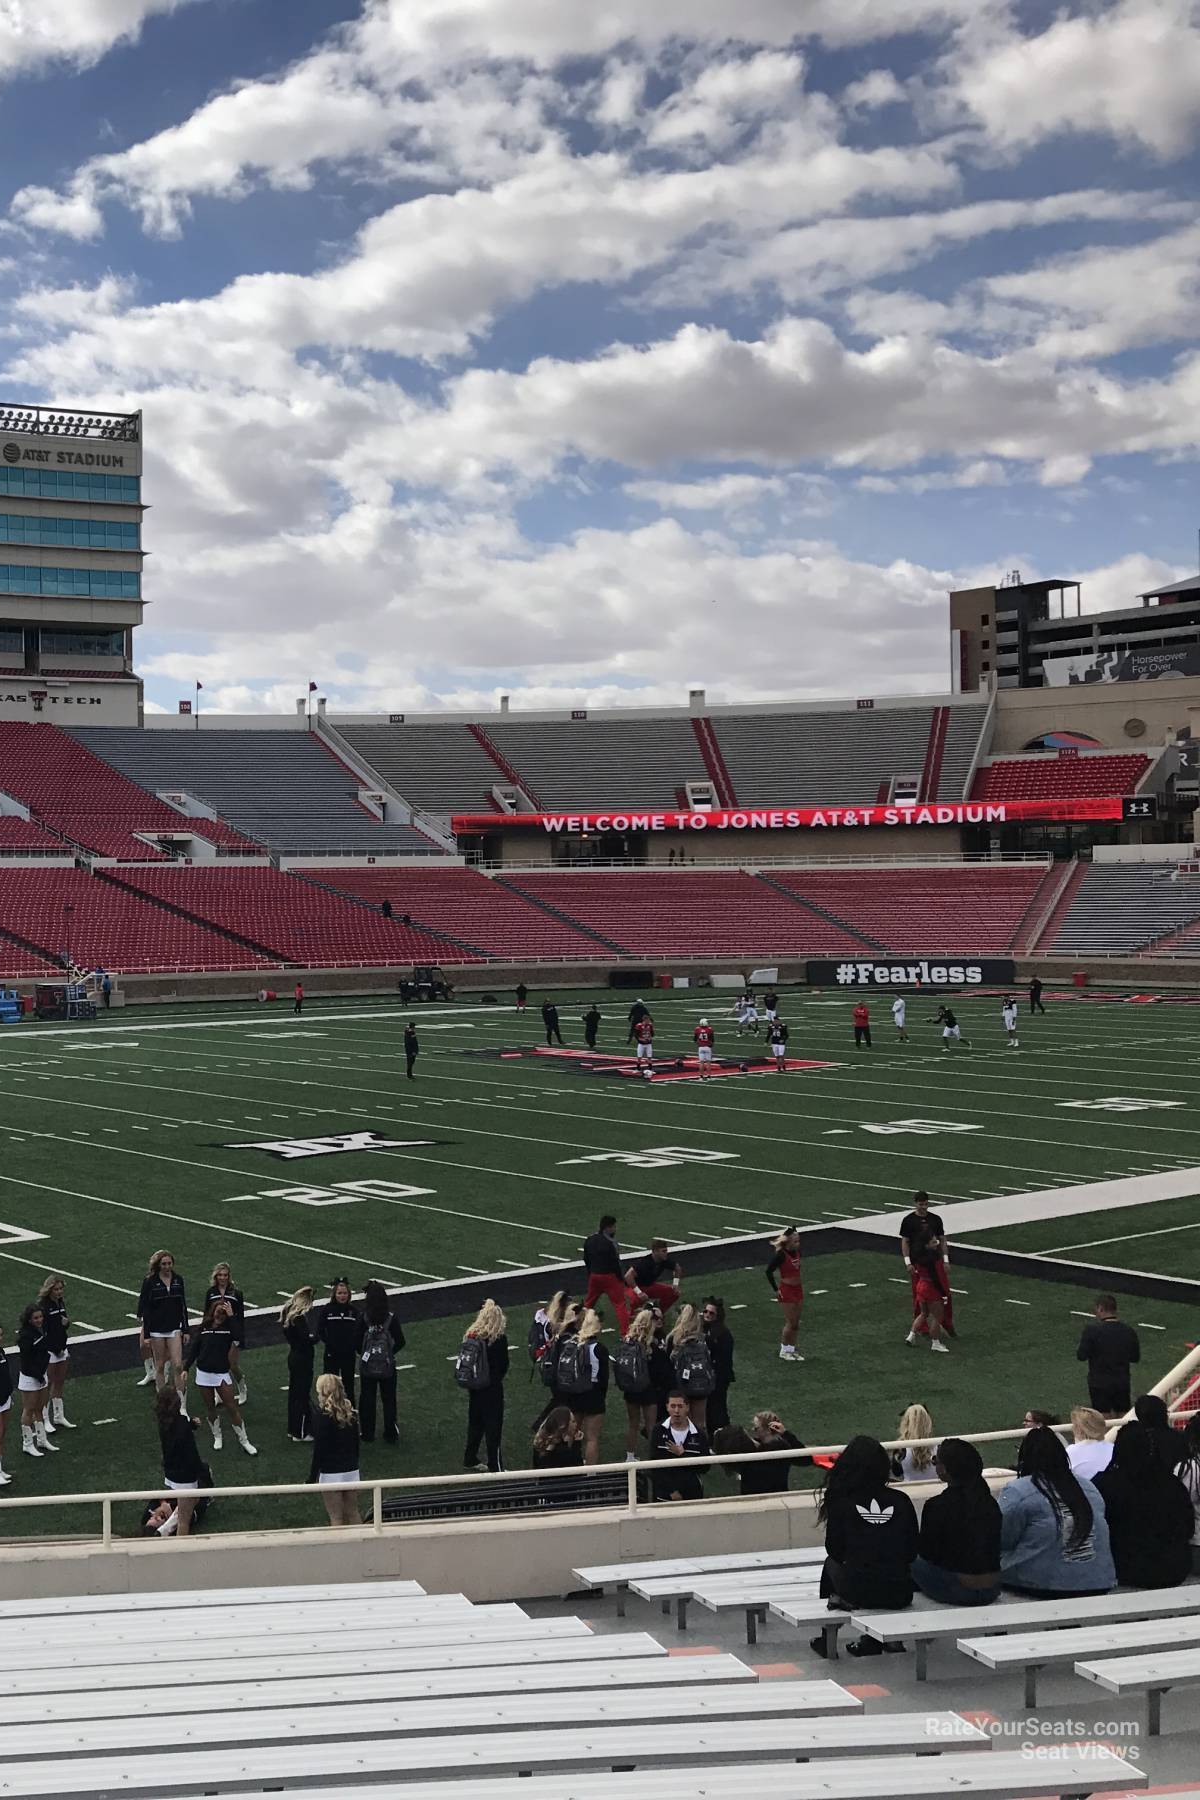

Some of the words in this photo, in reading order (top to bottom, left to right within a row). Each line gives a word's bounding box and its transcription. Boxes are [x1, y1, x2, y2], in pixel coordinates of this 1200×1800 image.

[22, 449, 51, 462] AT&T
[56, 451, 124, 468] STADIUM
[1132, 652, 1188, 665] Horsepower
[1132, 665, 1148, 674] For
[1149, 663, 1171, 673] Over
[50, 696, 102, 705] TECH
[542, 816, 666, 833] WELCOME
[674, 814, 707, 831] TO
[716, 811, 801, 829] JONES
[810, 809, 875, 828] AT&T
[883, 805, 1007, 824] STADIUM
[836, 961, 983, 985] #Fearless
[858, 1119, 985, 1135] 40
[583, 1146, 741, 1168] 30
[257, 1179, 437, 1206] 20
